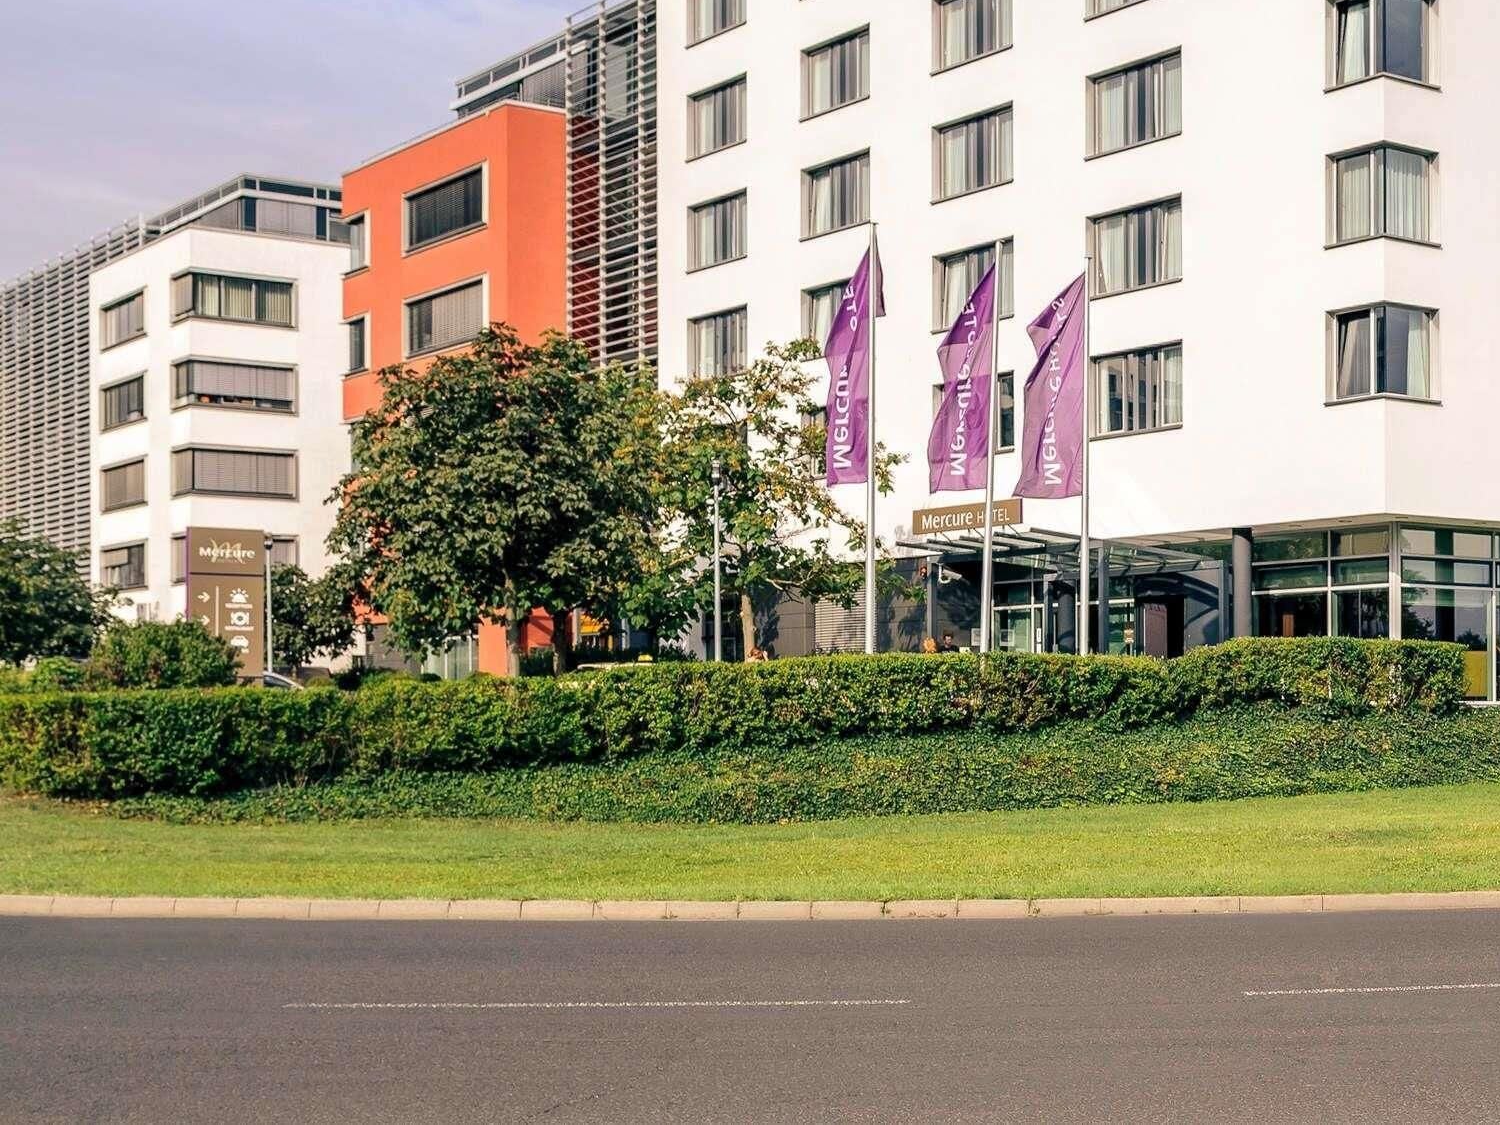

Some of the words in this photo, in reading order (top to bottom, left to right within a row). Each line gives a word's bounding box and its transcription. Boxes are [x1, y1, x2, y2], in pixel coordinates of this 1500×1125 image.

[921, 510, 973, 530] Mercure
[976, 507, 1010, 524] HTEL
[198, 545, 256, 559] Mercure
